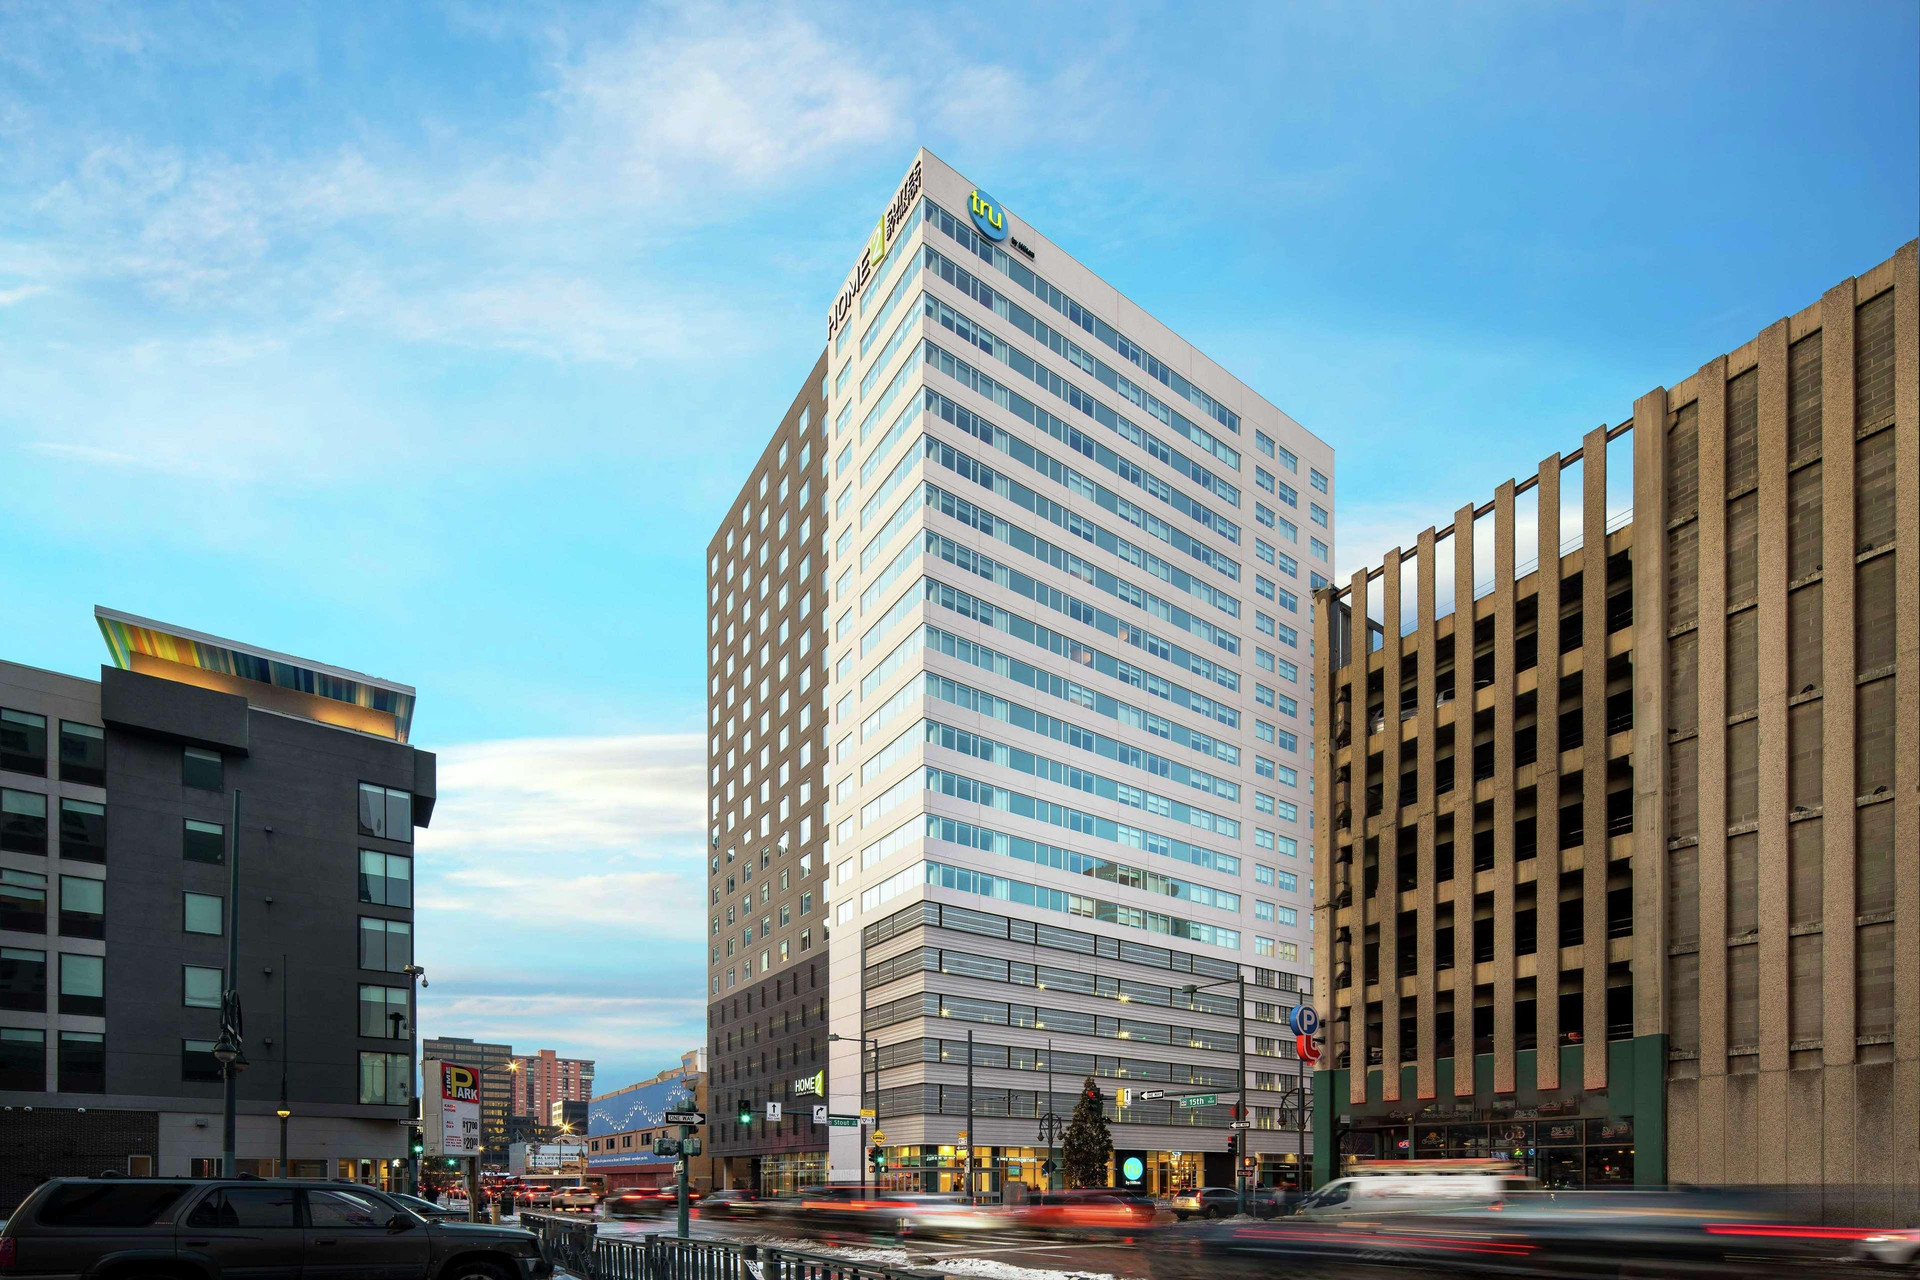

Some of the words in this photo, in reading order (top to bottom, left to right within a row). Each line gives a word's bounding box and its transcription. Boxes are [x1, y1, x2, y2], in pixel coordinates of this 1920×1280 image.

[887, 161, 921, 228] SUITES
[971, 189, 1002, 230] tru
[1011, 236, 1019, 247] by
[1303, 1009, 1316, 1031] P
[451, 1066, 479, 1101] PARK
[1189, 1097, 1205, 1106] 15th
[1124, 1162, 1140, 1175] tru
